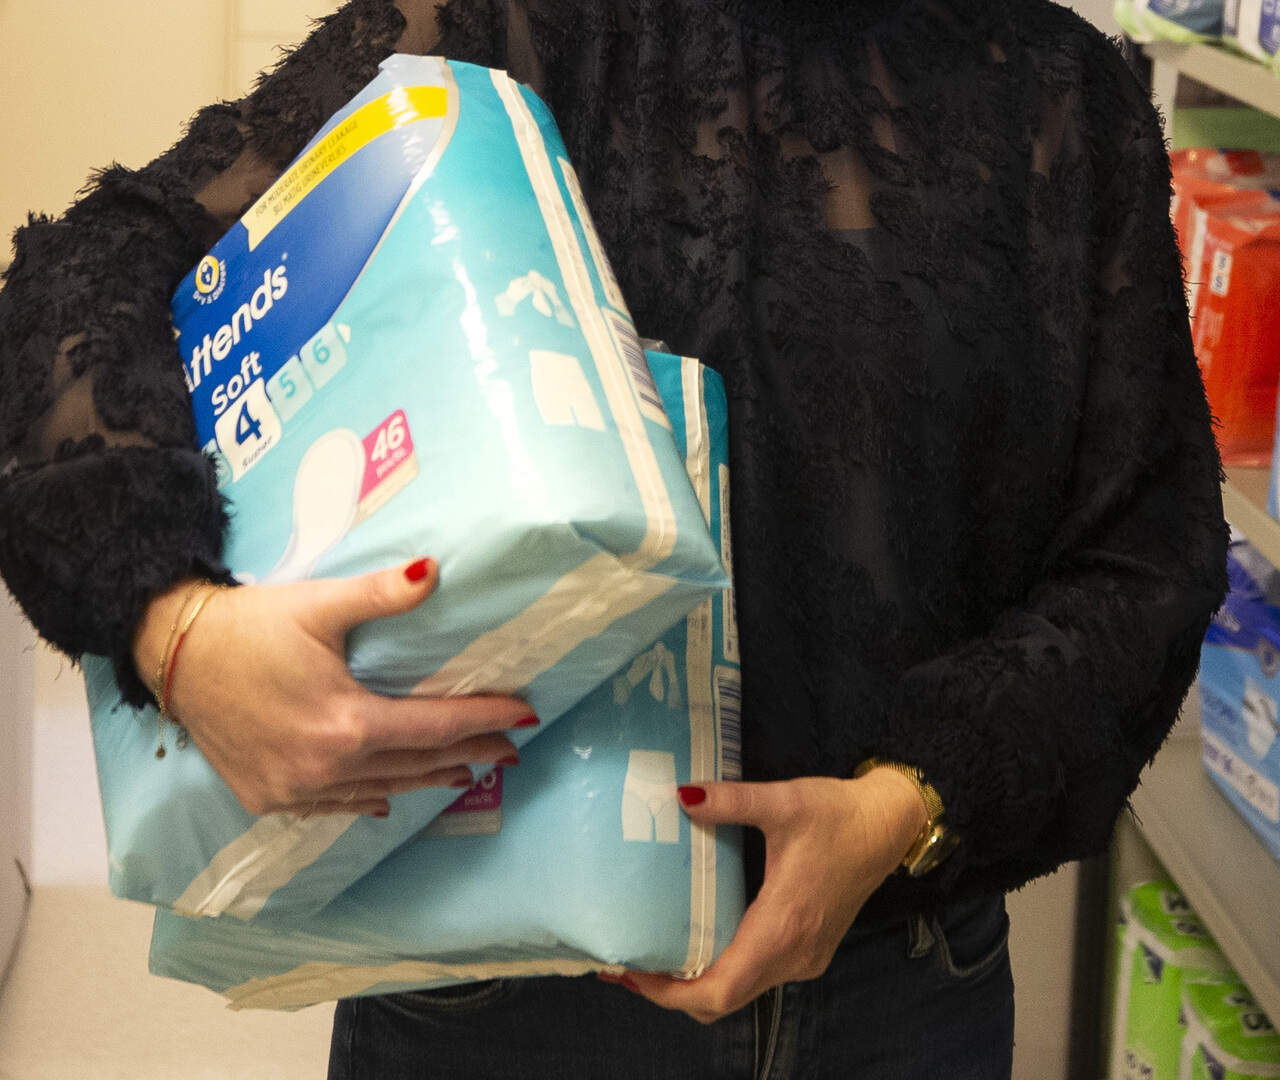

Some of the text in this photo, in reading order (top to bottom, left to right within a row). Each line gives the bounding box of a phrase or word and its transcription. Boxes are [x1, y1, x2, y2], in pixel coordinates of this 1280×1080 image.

[210, 350, 263, 417] Soft
[235, 337, 331, 447] 4 5 6
[242, 435, 273, 470] Super
[371, 415, 406, 462] 46
